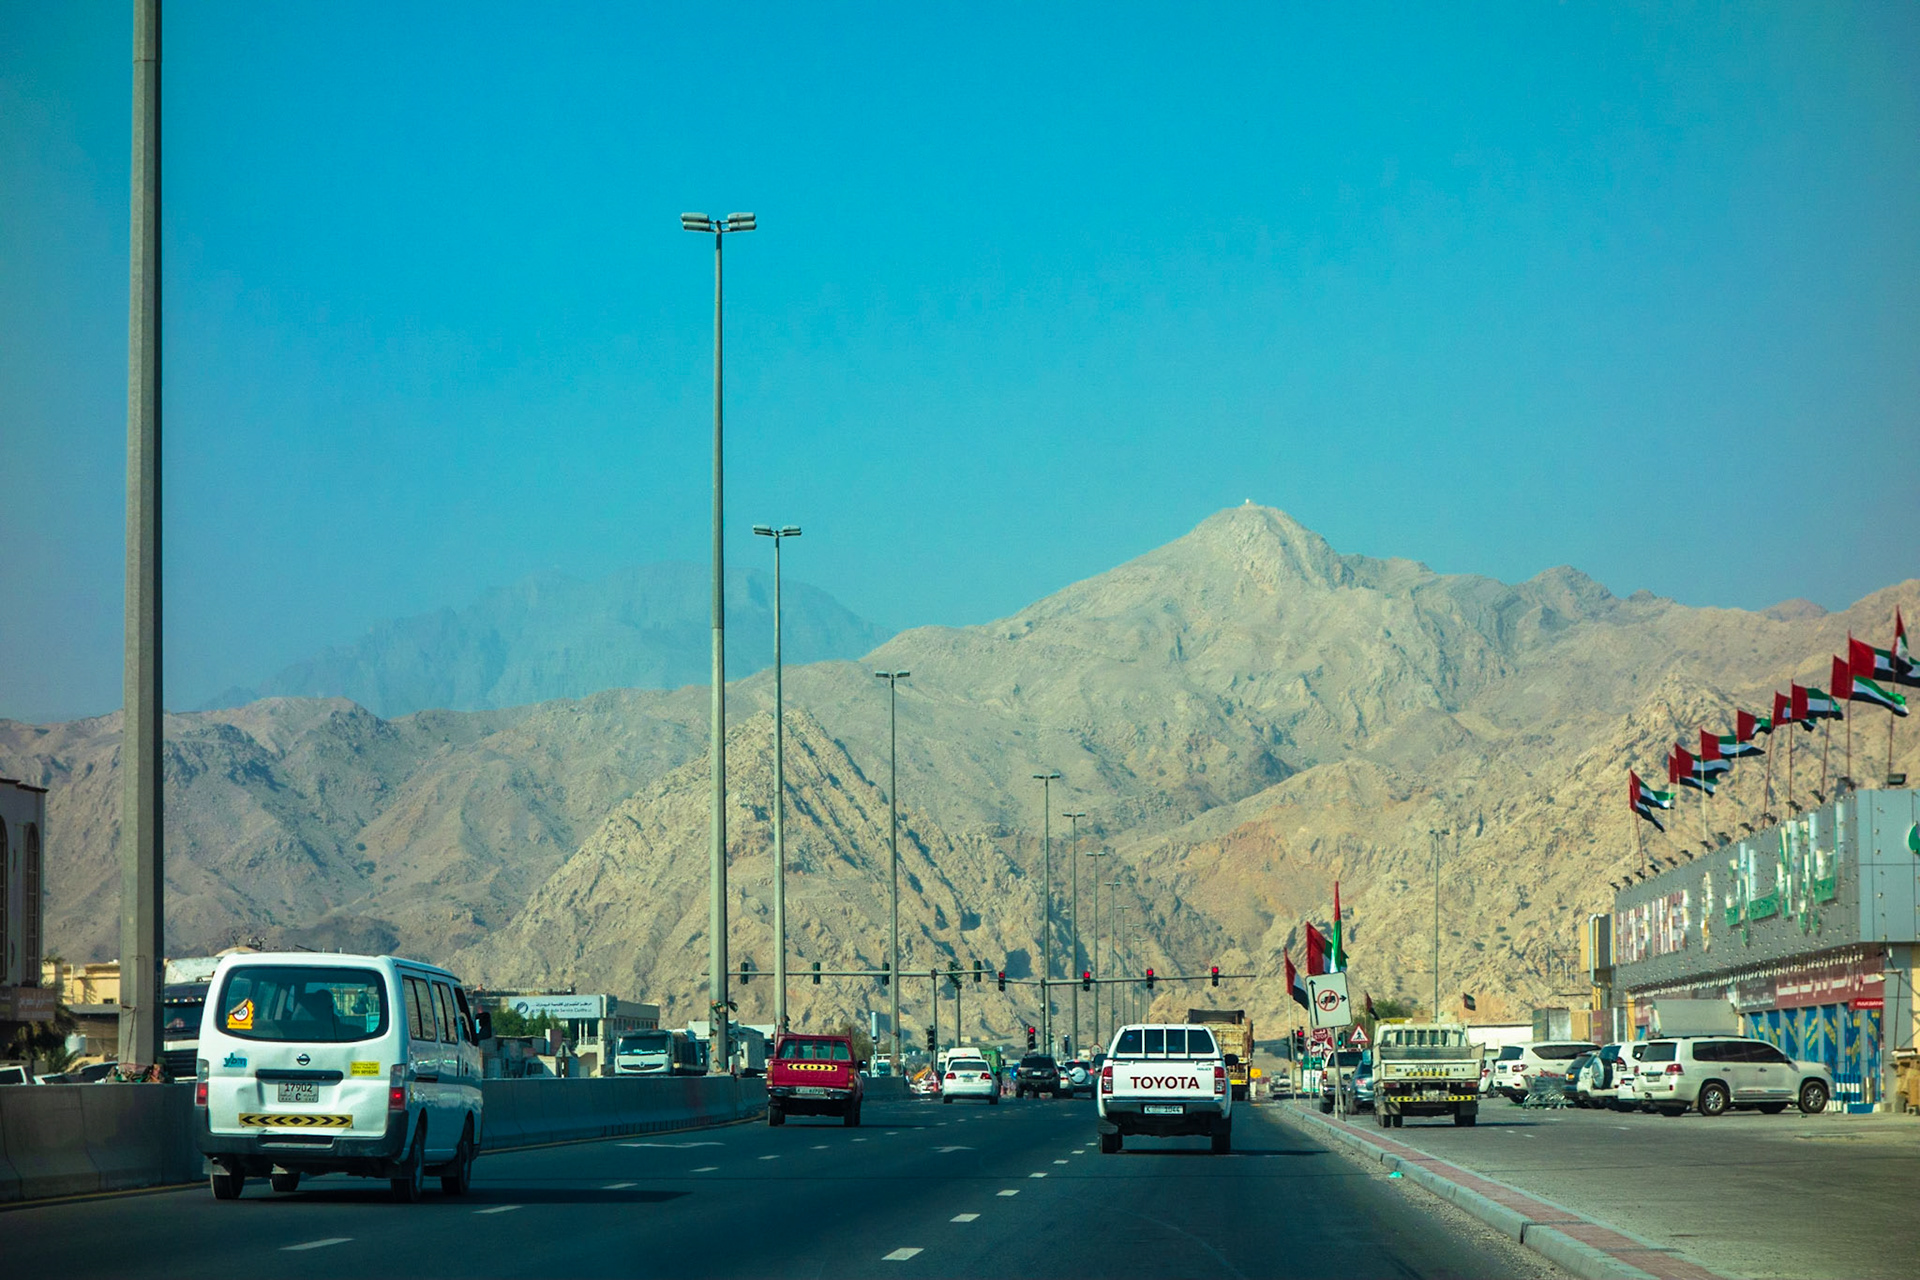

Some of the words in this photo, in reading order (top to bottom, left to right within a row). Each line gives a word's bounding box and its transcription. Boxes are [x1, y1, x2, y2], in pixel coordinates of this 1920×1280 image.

[1130, 1076, 1200, 1089] TOYOTA
[285, 1083, 312, 1092] 17902
[295, 1093, 301, 1101] C
